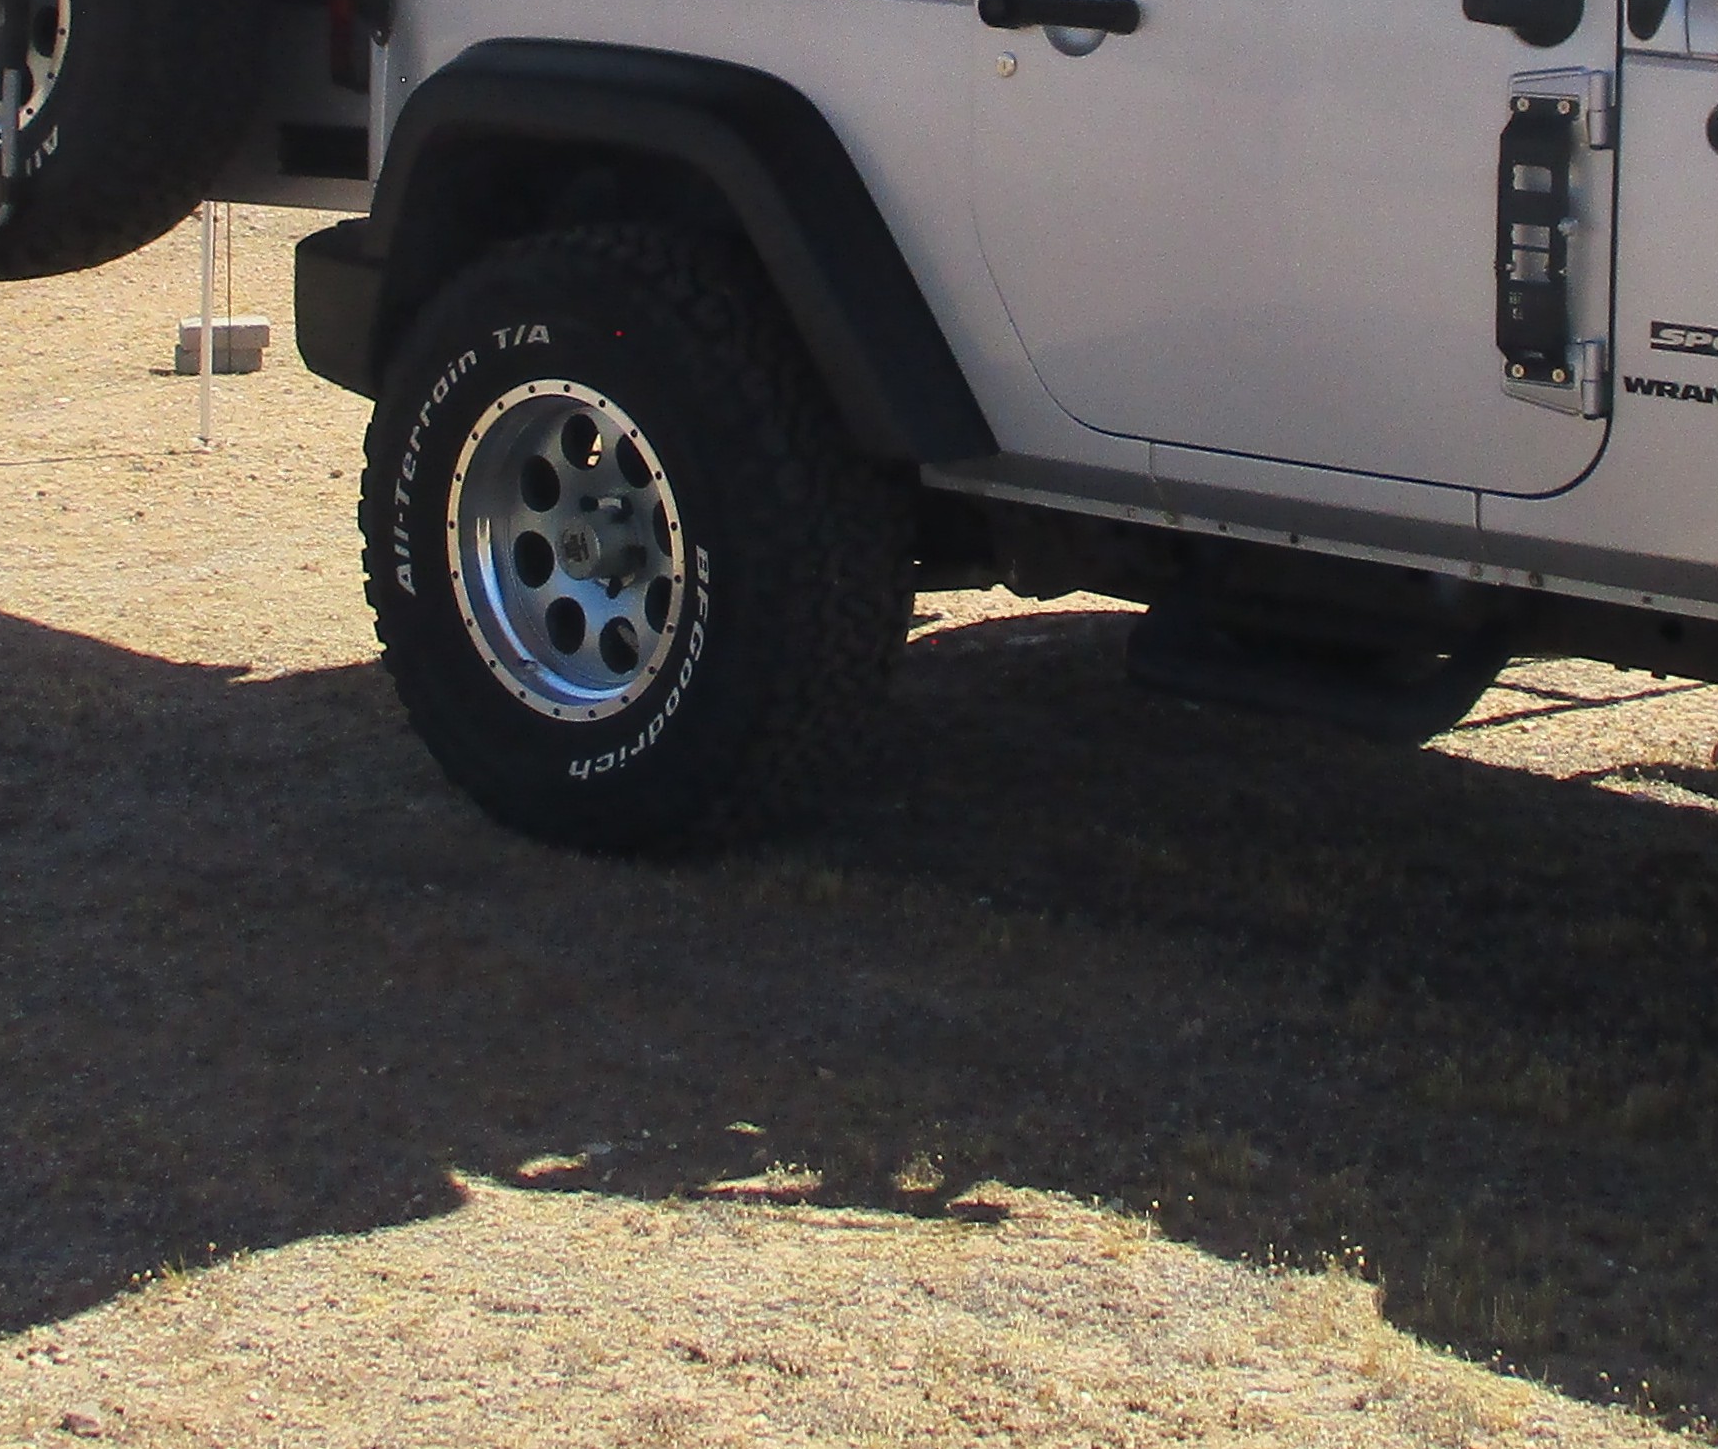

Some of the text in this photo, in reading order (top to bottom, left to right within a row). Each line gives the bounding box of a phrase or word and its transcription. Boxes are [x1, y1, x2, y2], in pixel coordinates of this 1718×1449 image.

[395, 323, 550, 596] All-Terrain T/A
[568, 545, 710, 780] BFGoodrich
